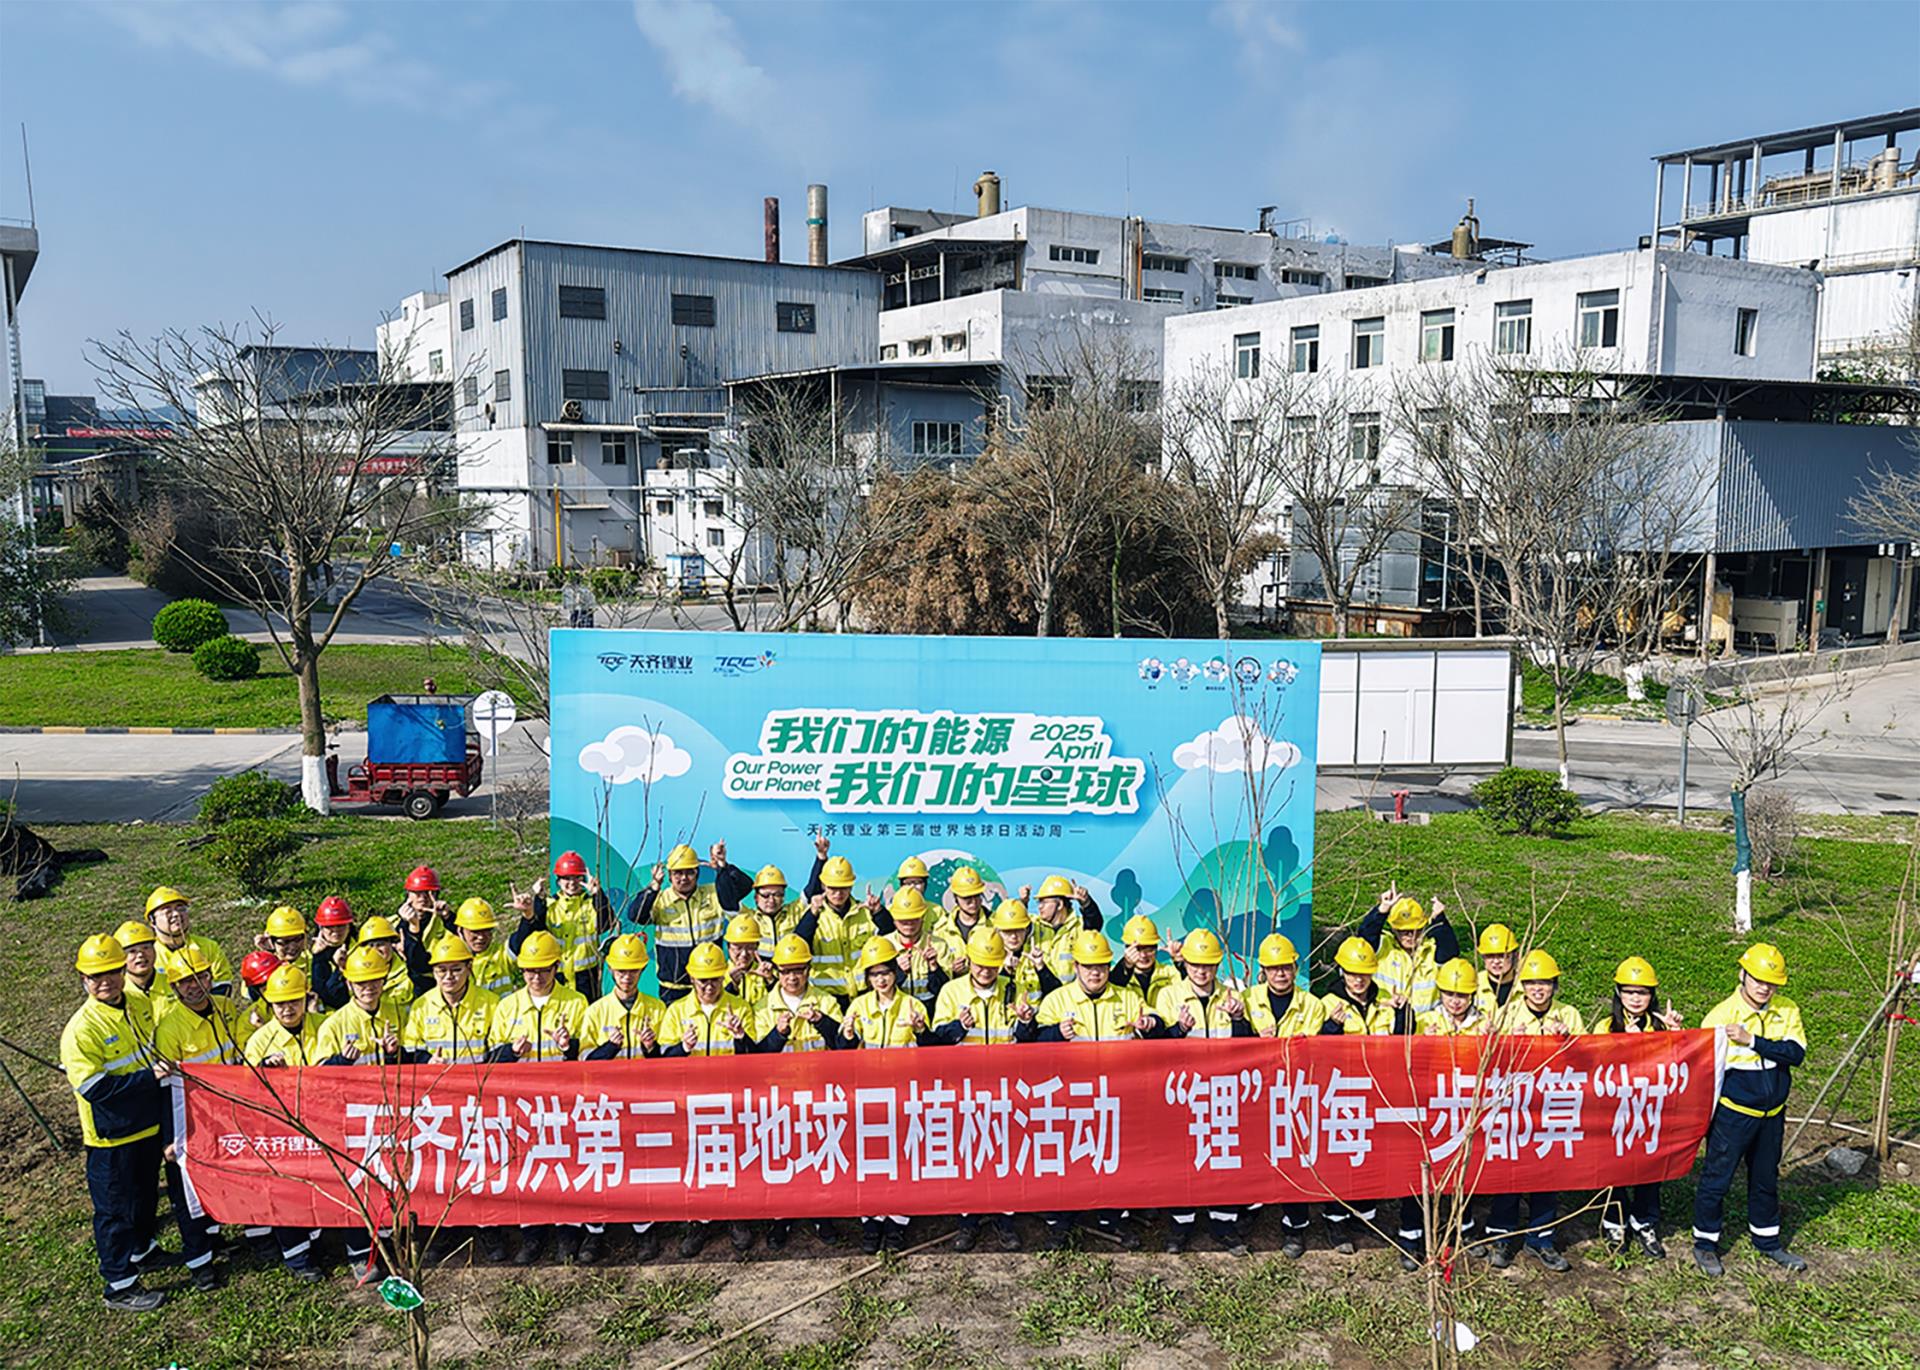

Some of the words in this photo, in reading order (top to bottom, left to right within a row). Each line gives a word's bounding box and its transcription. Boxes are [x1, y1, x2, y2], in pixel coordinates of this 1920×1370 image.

[629, 654, 693, 669] 天齐锂业
[767, 716, 1014, 755] 我们的能源
[1029, 723, 1094, 741] 2025
[1045, 742, 1103, 763] April
[732, 761, 762, 775] Our
[767, 762, 823, 776] Power
[730, 777, 762, 792] Our
[766, 778, 821, 793] Planet
[825, 762, 1137, 807] 我们的星球
[806, 824, 1063, 838] 天齐锂业第三届世界地球日活动周
[344, 1075, 1121, 1195] 天齐射洪第三届地球日植树活动
[254, 1136, 322, 1152] 天齐锂业
